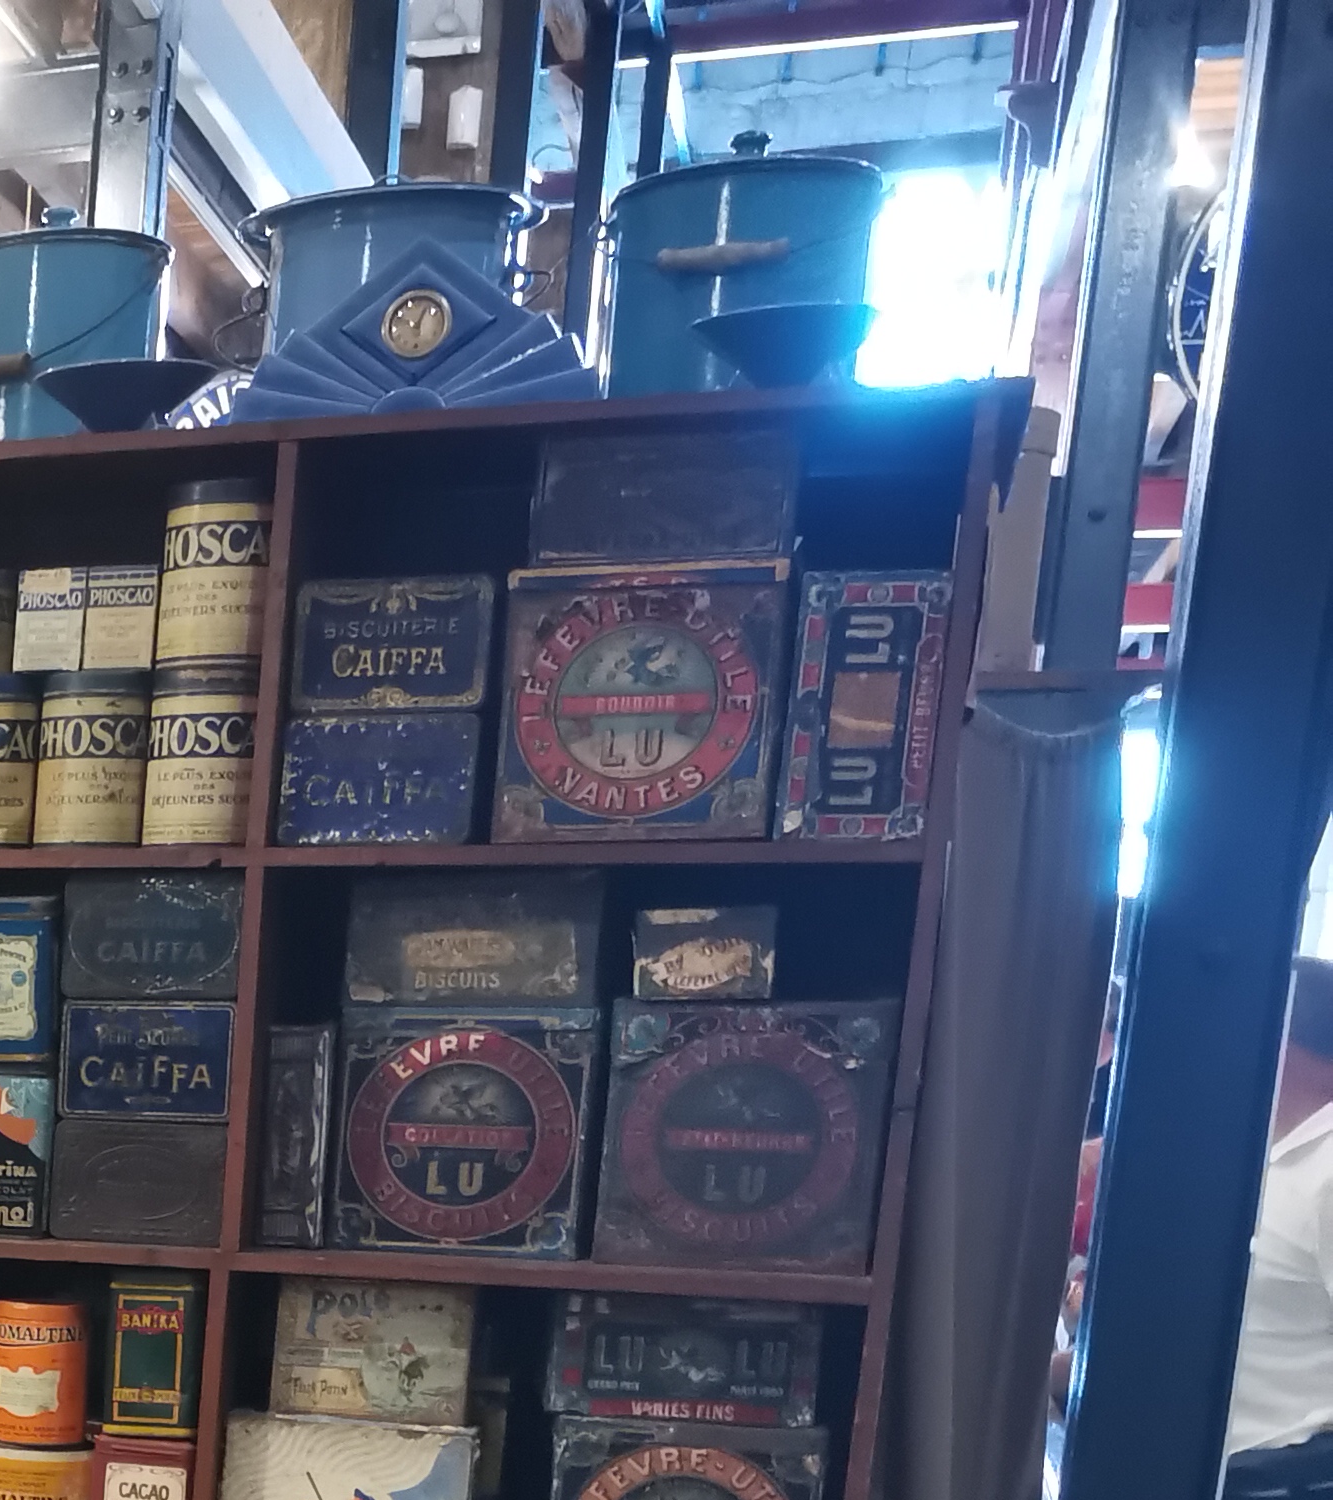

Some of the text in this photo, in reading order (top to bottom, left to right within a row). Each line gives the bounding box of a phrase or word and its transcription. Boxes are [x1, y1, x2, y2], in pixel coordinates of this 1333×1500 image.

[19, 591, 82, 609] PHOSCAO
[89, 589, 153, 607] PHOSCAO
[845, 612, 895, 665] LU
[598, 725, 664, 768] LU
[829, 754, 878, 807] LU
[425, 1160, 485, 1197] LU
[593, 1335, 645, 1373] LU
